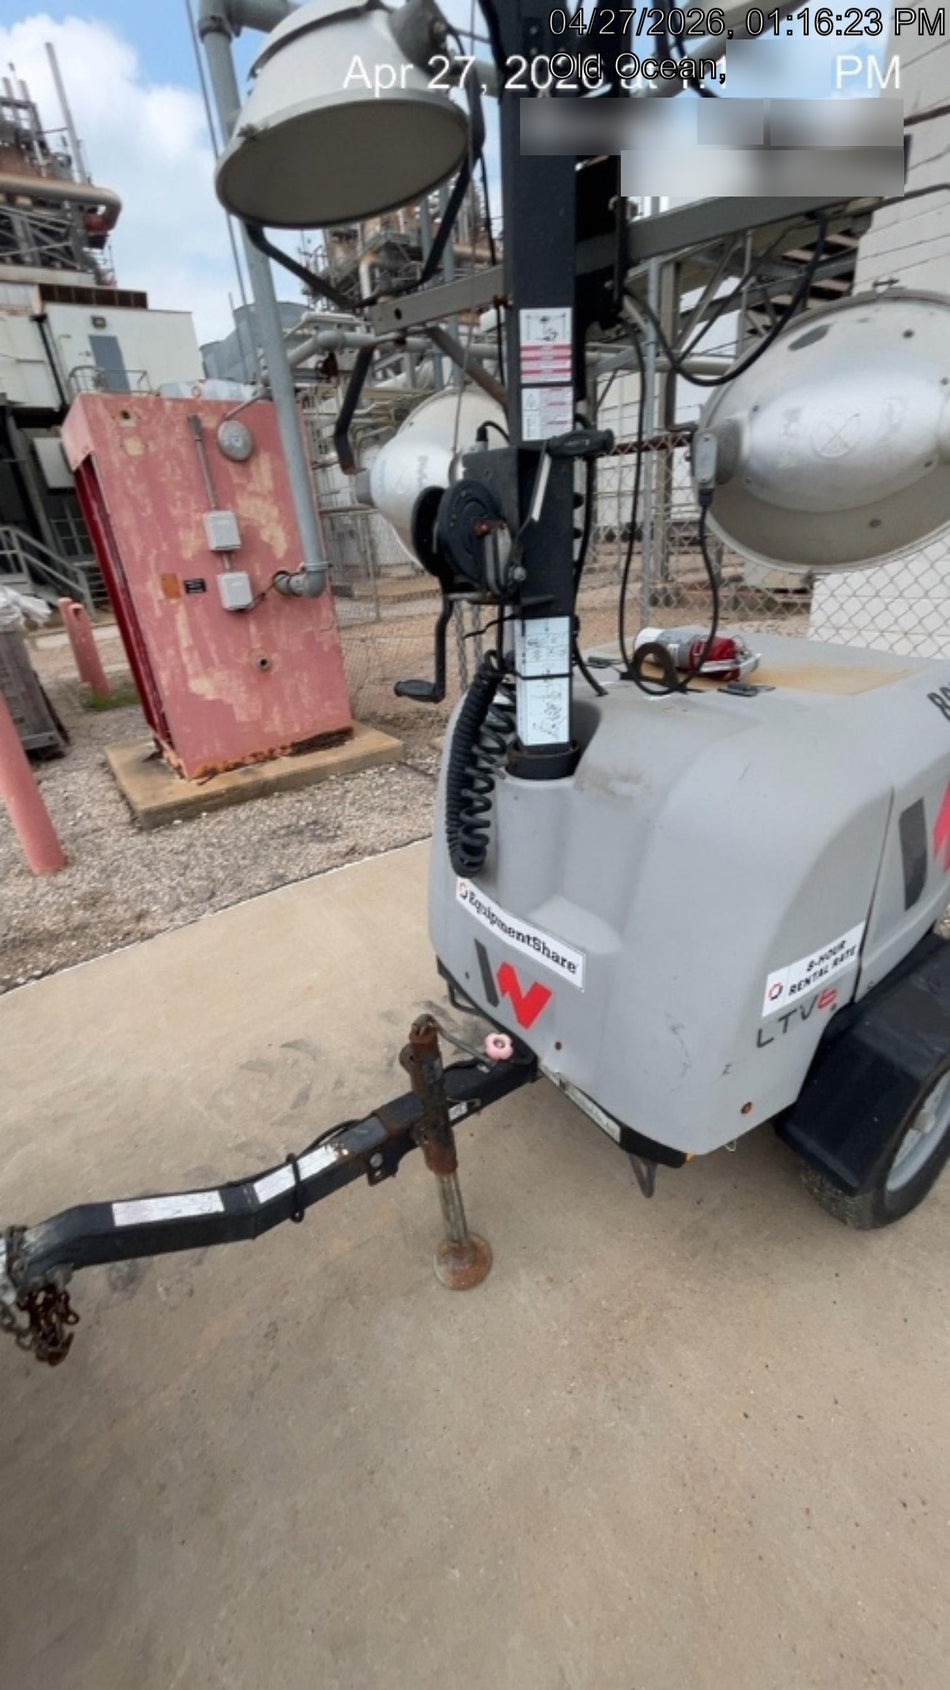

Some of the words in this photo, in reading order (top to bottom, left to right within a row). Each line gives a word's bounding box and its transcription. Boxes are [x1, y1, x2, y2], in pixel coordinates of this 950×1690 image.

[468, 888, 578, 975] EquipmentShare
[787, 964, 829, 995] RENTAL
[831, 945, 857, 969] RATE
